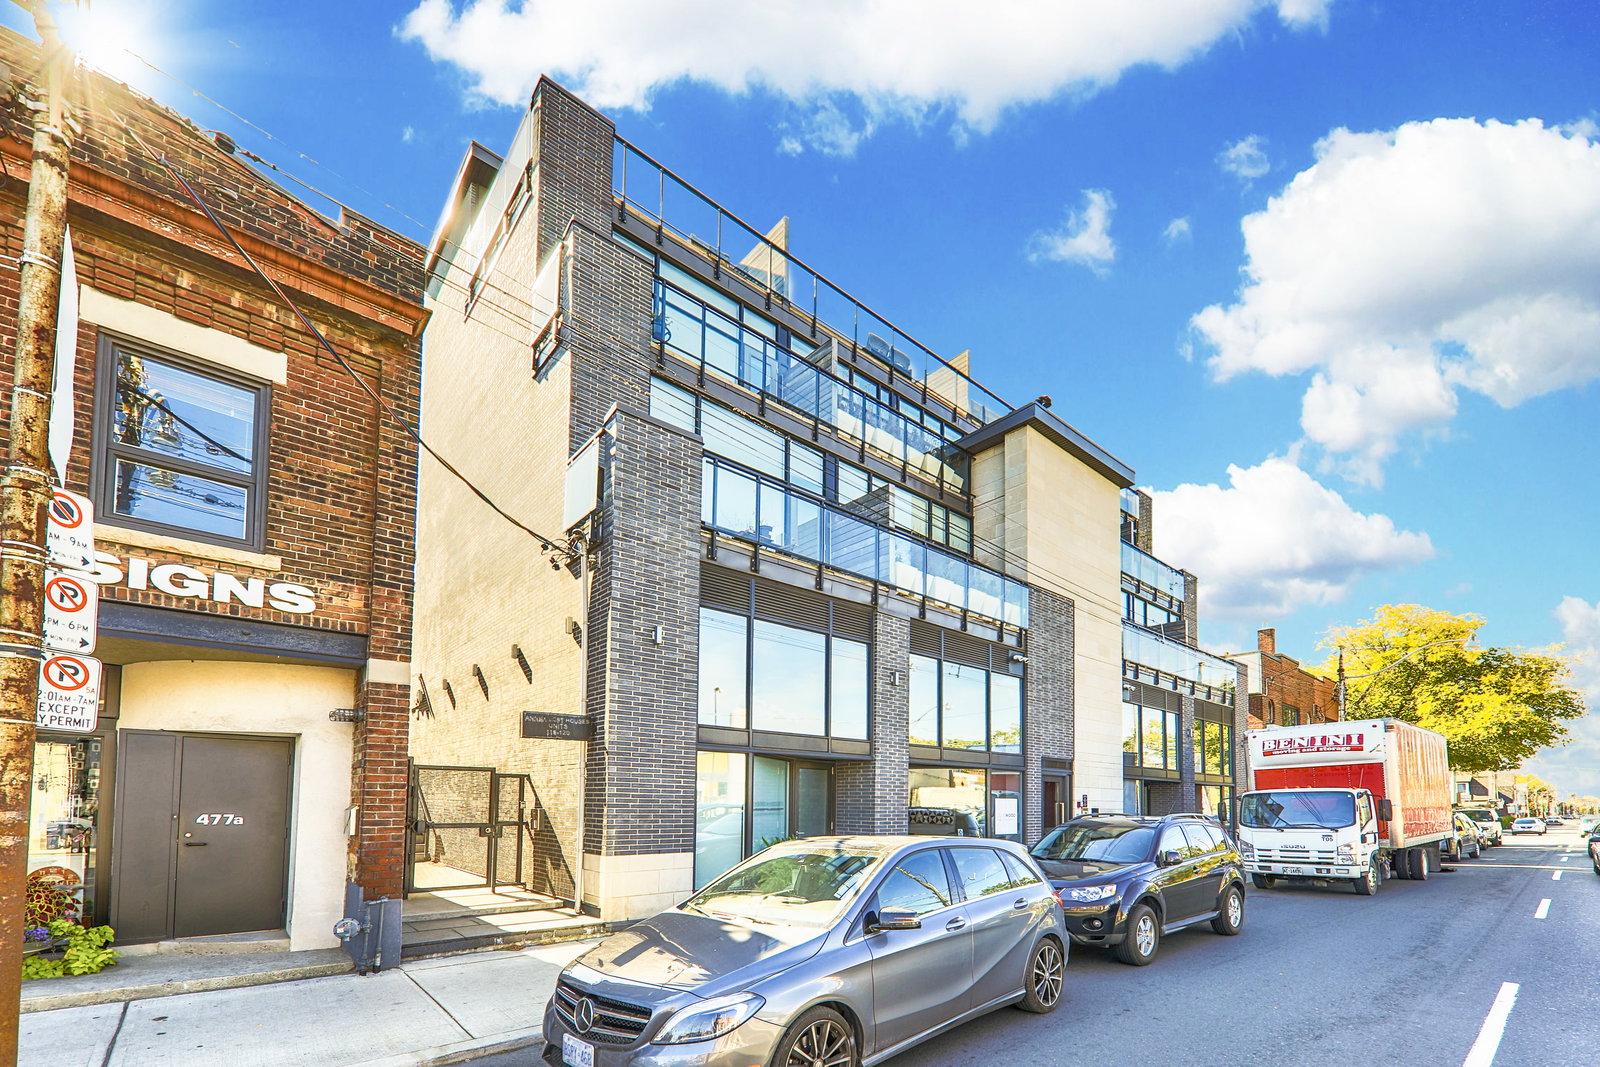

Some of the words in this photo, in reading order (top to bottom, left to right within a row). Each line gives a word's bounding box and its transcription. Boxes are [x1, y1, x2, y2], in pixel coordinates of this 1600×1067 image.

[76, 550, 316, 614] SIGNS
[68, 620, 89, 632] 6PM
[38, 701, 86, 717] EXCEPT
[38, 713, 47, 724] Y
[49, 714, 91, 728] PERMIT
[1262, 733, 1364, 752] BENINI
[1272, 748, 1301, 756] moving
[195, 813, 245, 826] 477a
